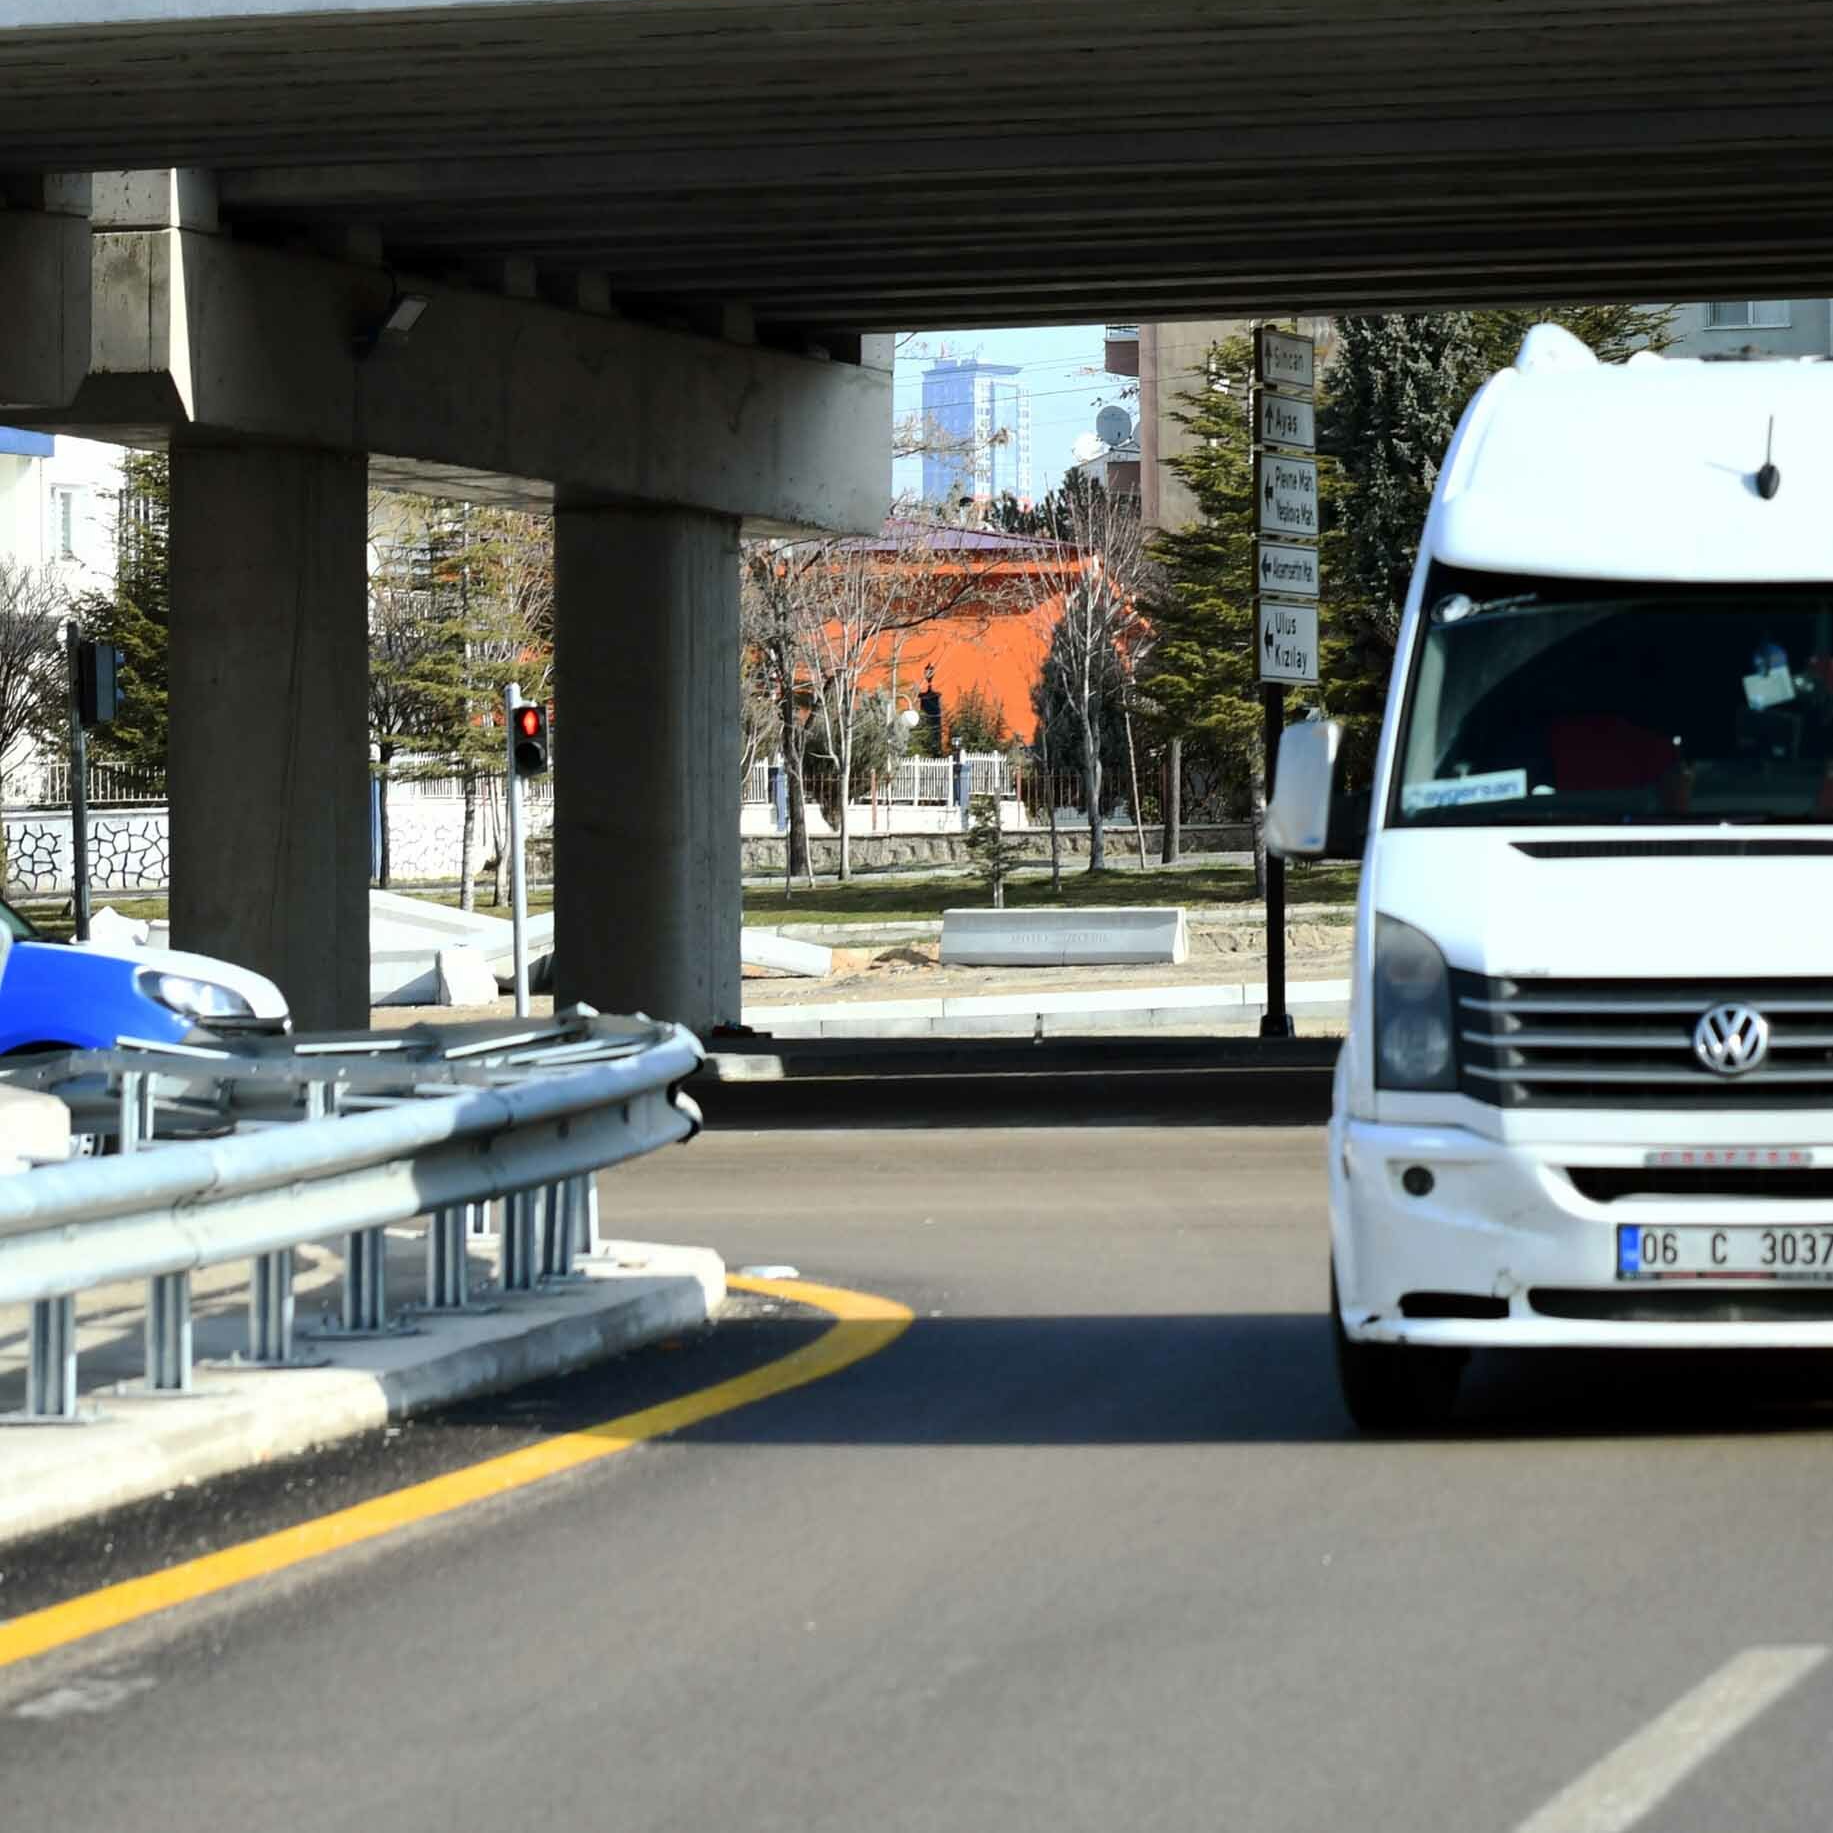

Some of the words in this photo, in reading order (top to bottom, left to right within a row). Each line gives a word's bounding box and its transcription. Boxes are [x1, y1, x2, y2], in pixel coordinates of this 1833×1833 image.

[1275, 612, 1297, 635] Ulus
[1642, 1232, 1679, 1265] 06
[1711, 1232, 1728, 1265] C
